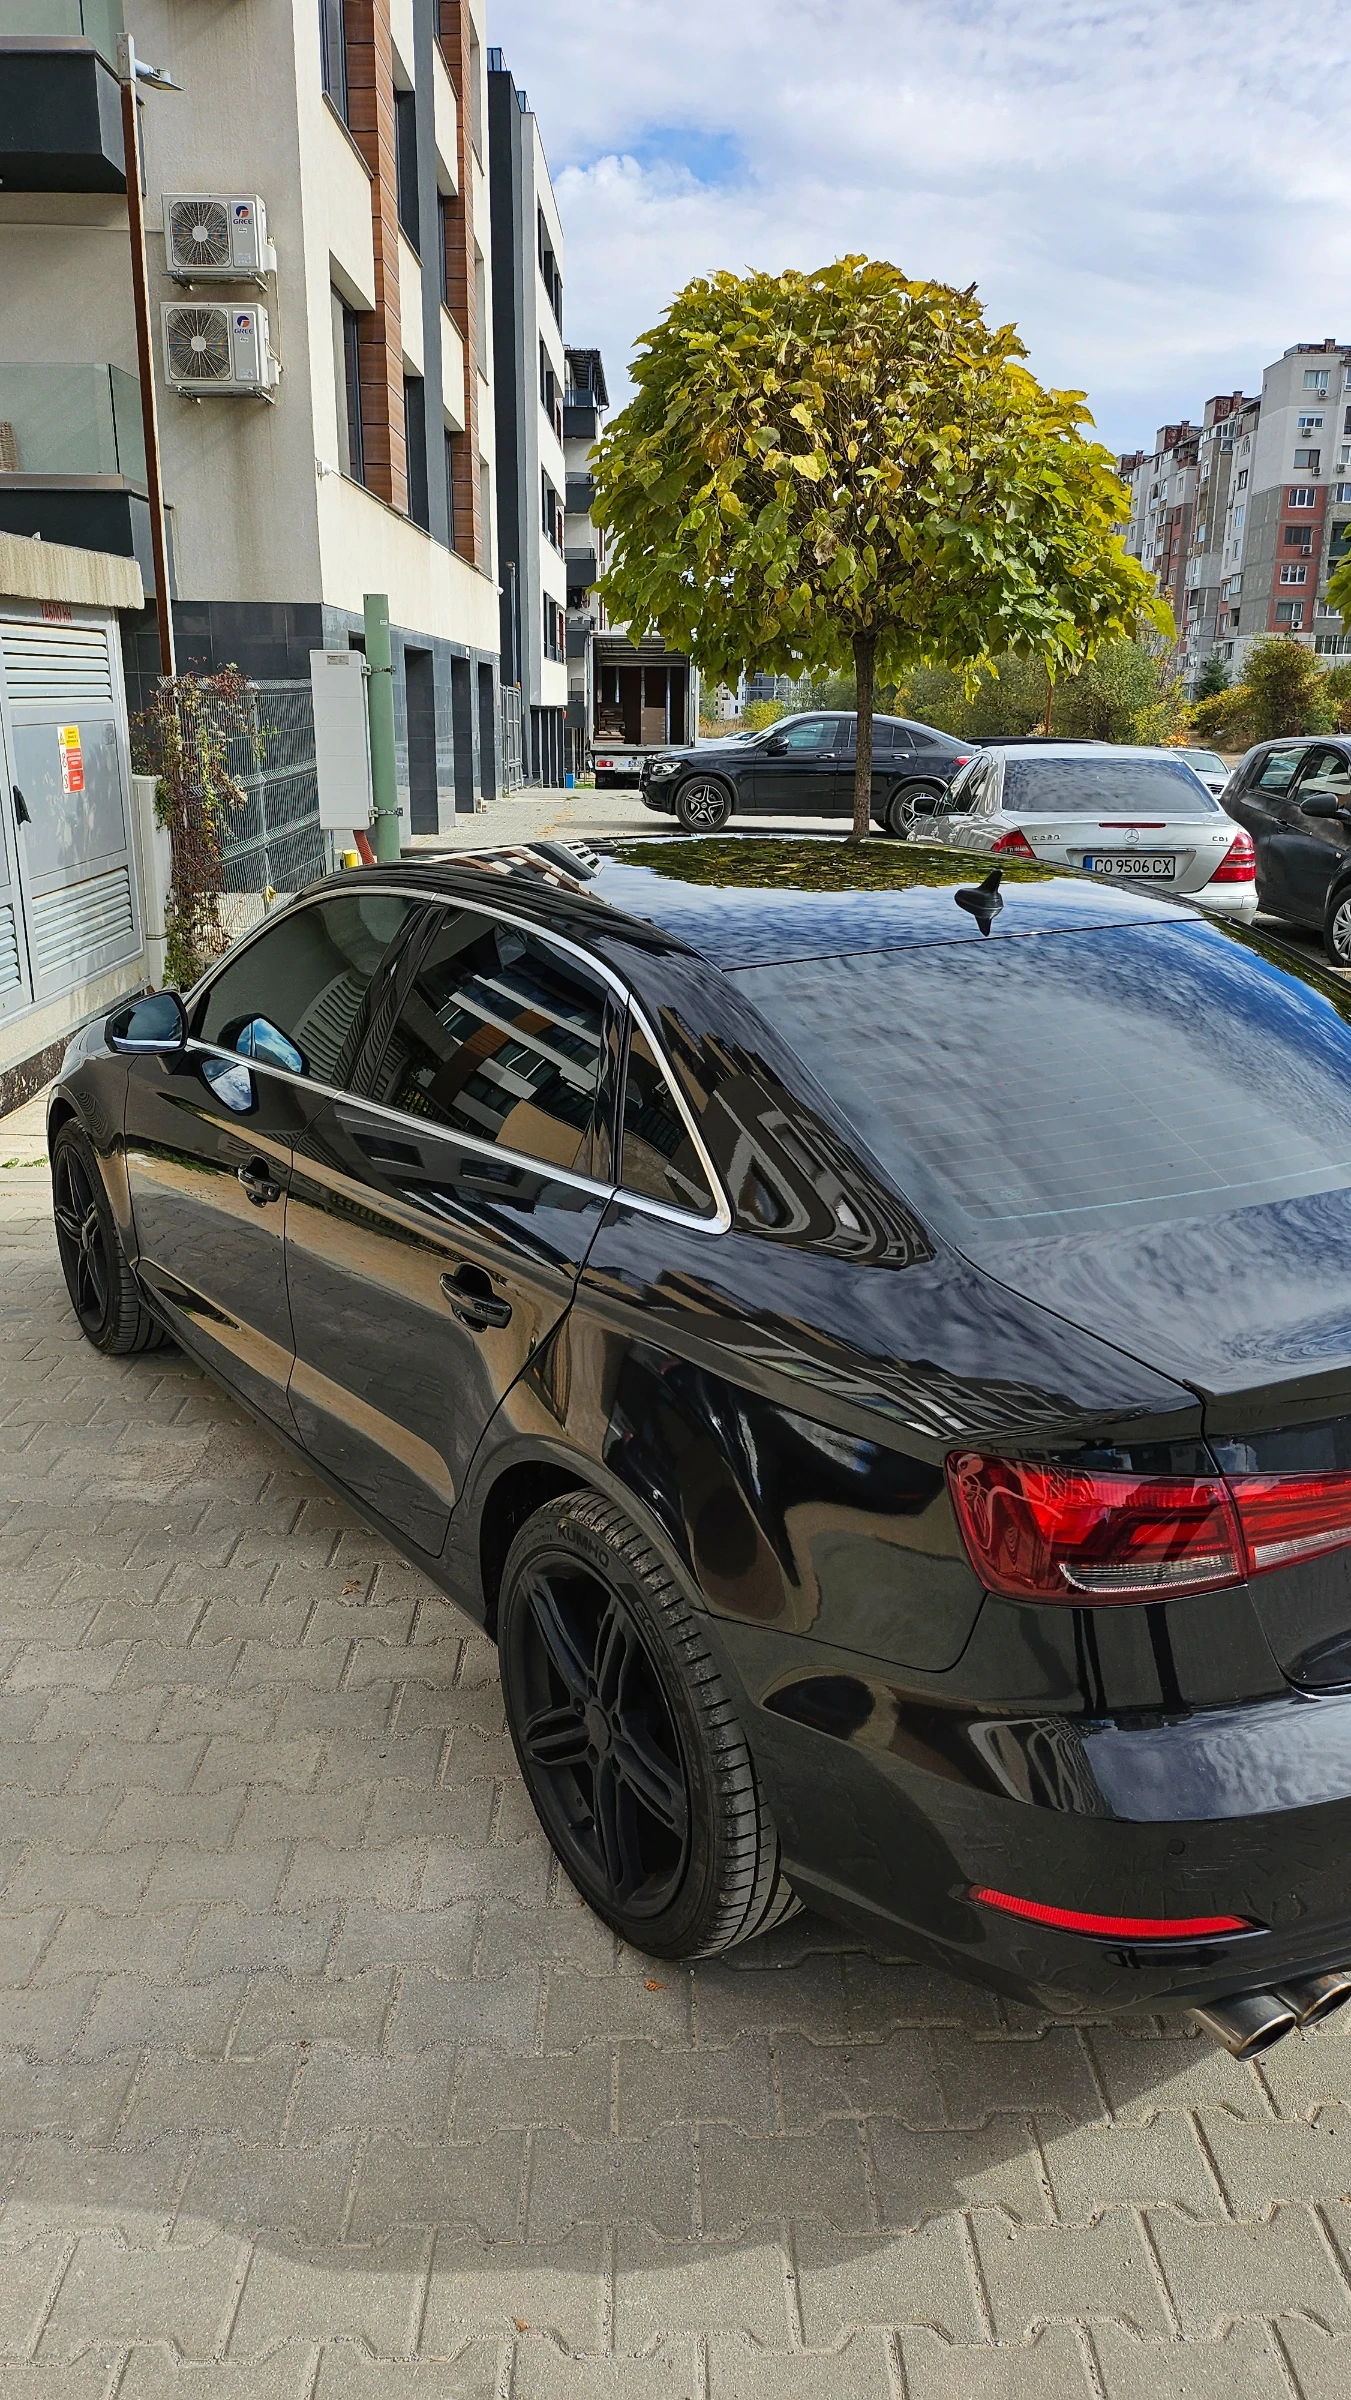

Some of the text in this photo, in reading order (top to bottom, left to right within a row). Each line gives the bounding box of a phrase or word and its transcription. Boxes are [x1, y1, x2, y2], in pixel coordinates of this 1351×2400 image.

[1116, 860, 1149, 873] 9506
[1153, 860, 1171, 873] CX
[557, 1523, 610, 1569] KUMHO
